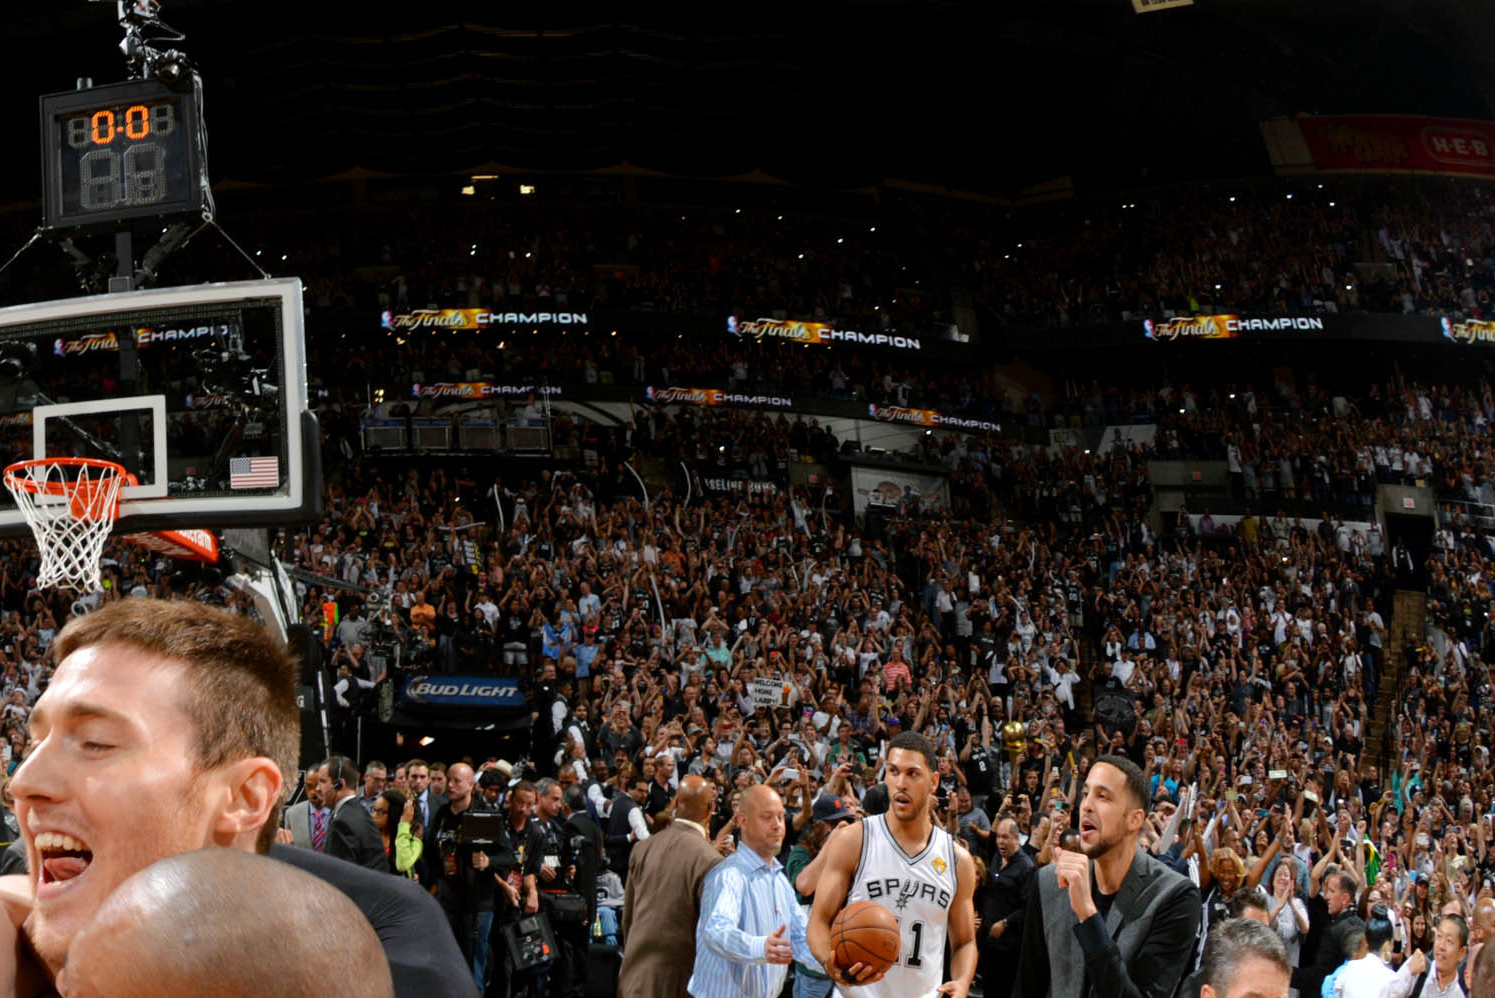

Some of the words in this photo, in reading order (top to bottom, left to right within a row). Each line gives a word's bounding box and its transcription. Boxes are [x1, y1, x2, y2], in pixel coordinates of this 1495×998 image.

[476, 313, 588, 324] CHAMPION
[1226, 317, 1323, 331] CHAMPION
[817, 328, 921, 350] CHAMPION
[713, 393, 792, 407] CHAMPION
[930, 414, 1001, 432] CHAMPION
[414, 682, 458, 696] BUD
[459, 684, 519, 697] LIGHT
[867, 878, 951, 910] SPURS
